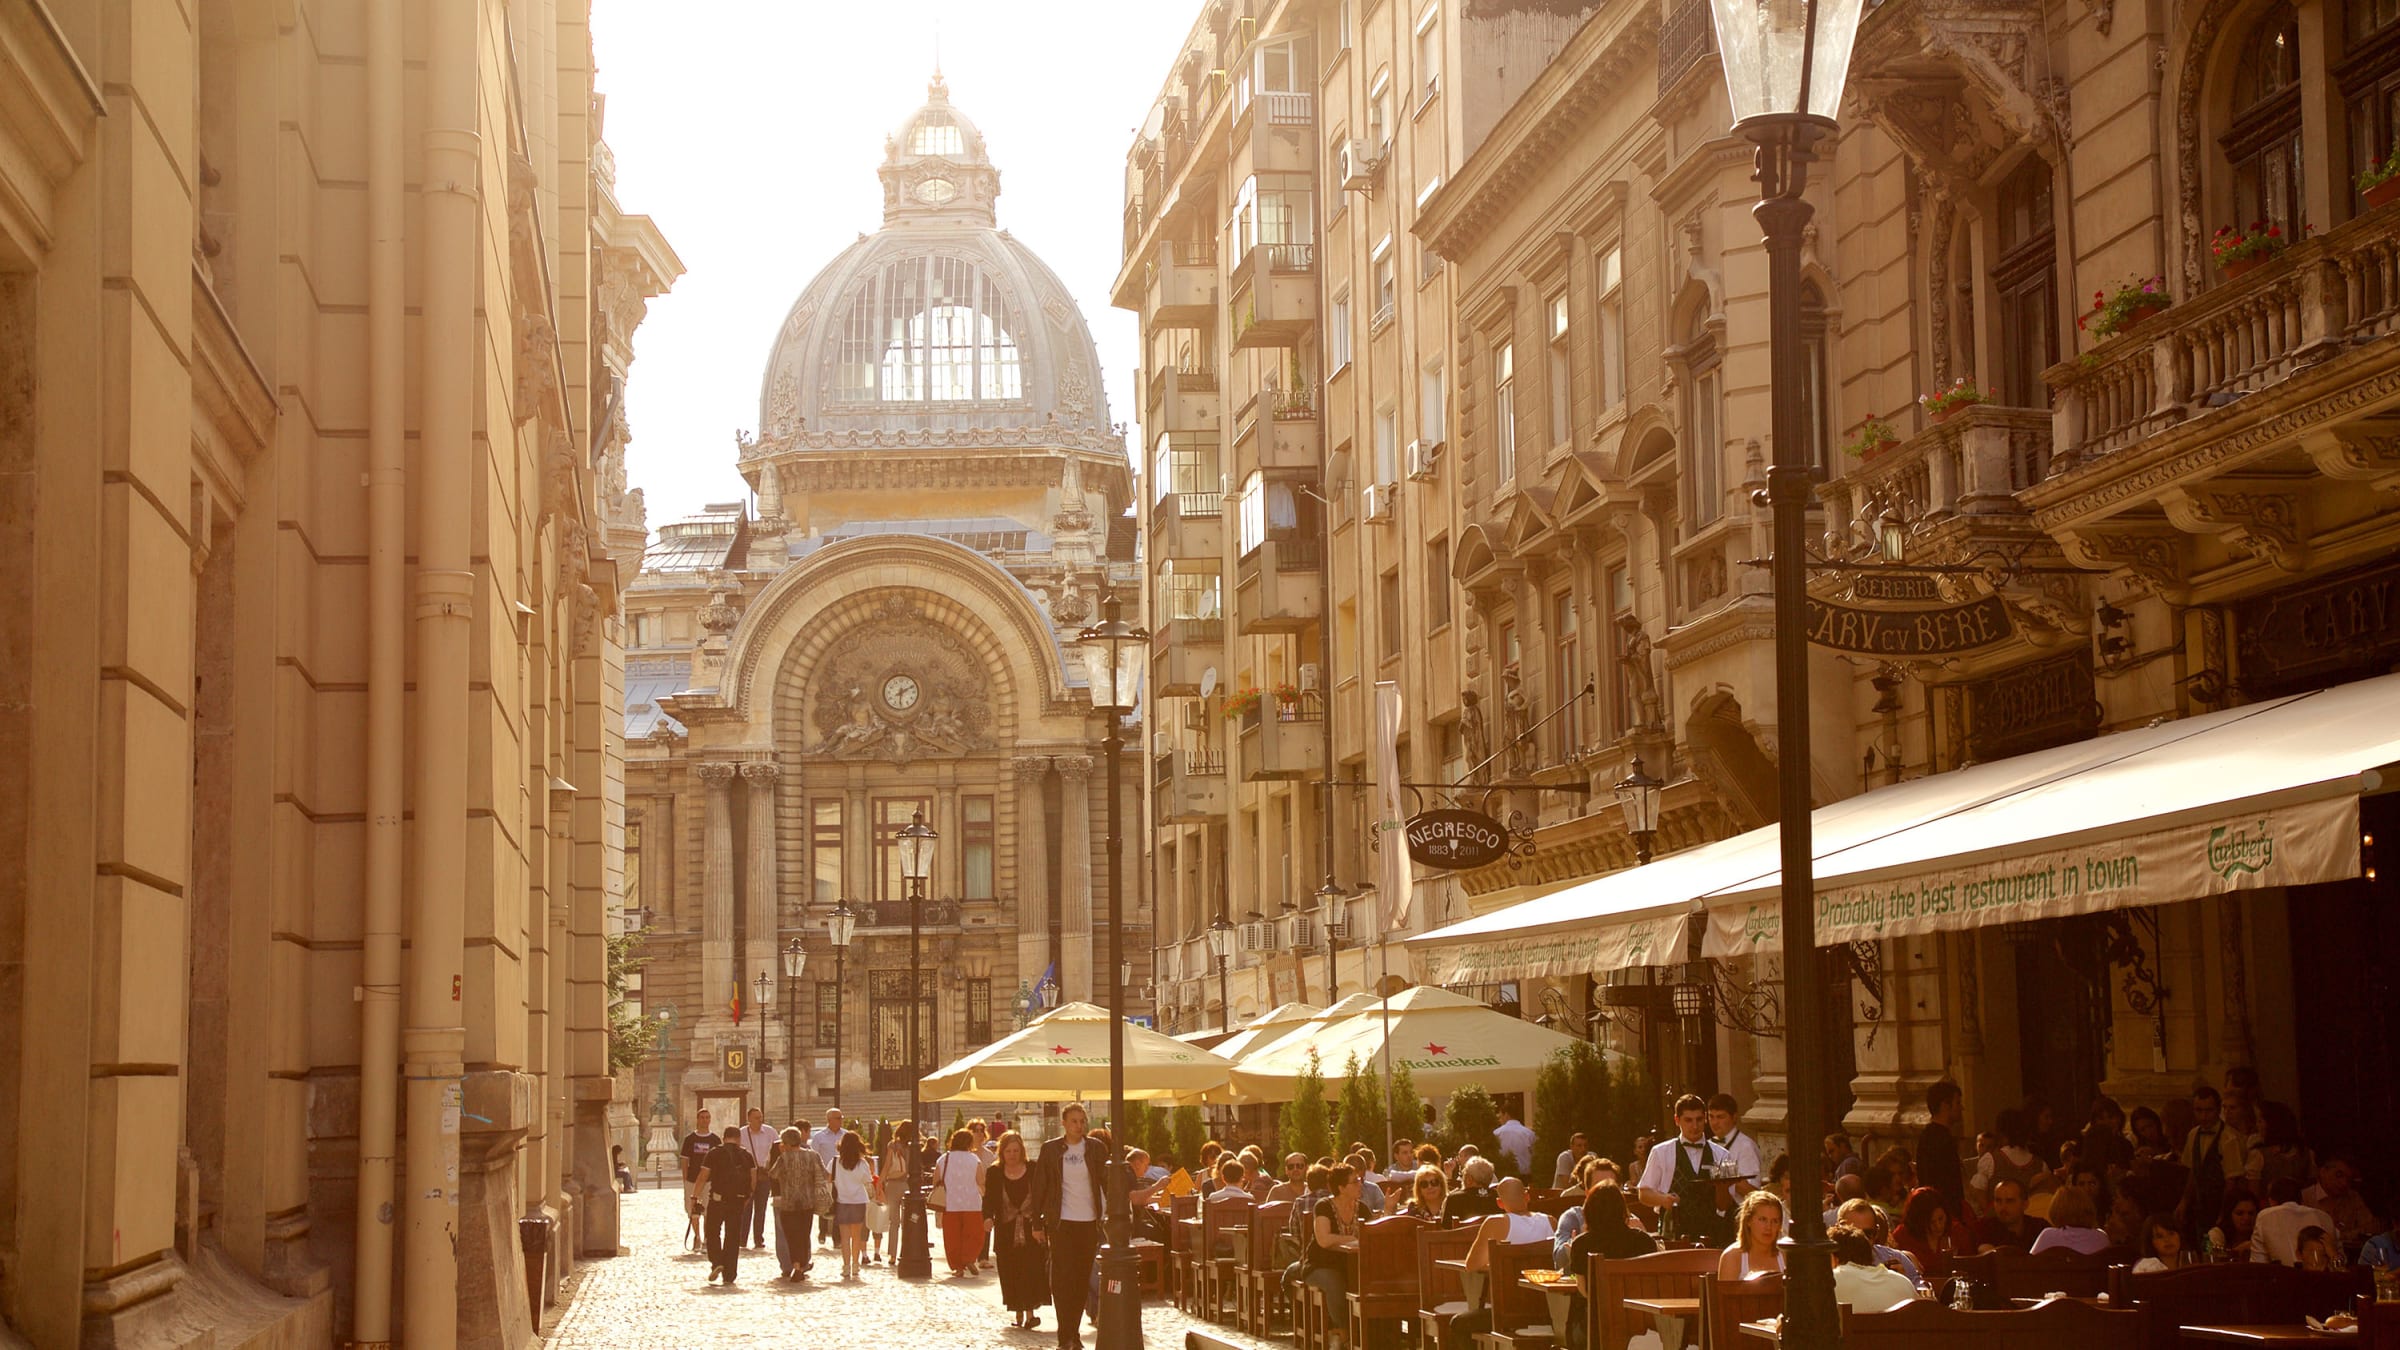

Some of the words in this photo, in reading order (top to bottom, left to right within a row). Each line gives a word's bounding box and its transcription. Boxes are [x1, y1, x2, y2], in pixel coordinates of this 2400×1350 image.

[1856, 577, 1936, 598] BERERIE
[1914, 604, 1998, 651] BERE
[1409, 822, 1500, 849] NEGRESCO
[1429, 845, 1449, 855] 1883
[1459, 845, 1479, 857] 2011
[2207, 822, 2273, 879] Carlsberg
[1819, 889, 1884, 932] Probably
[1889, 884, 1915, 918] the
[1921, 880, 1956, 915] best
[1962, 865, 2057, 910] restaurant
[2062, 857, 2079, 897] in
[2086, 856, 2139, 893] town
